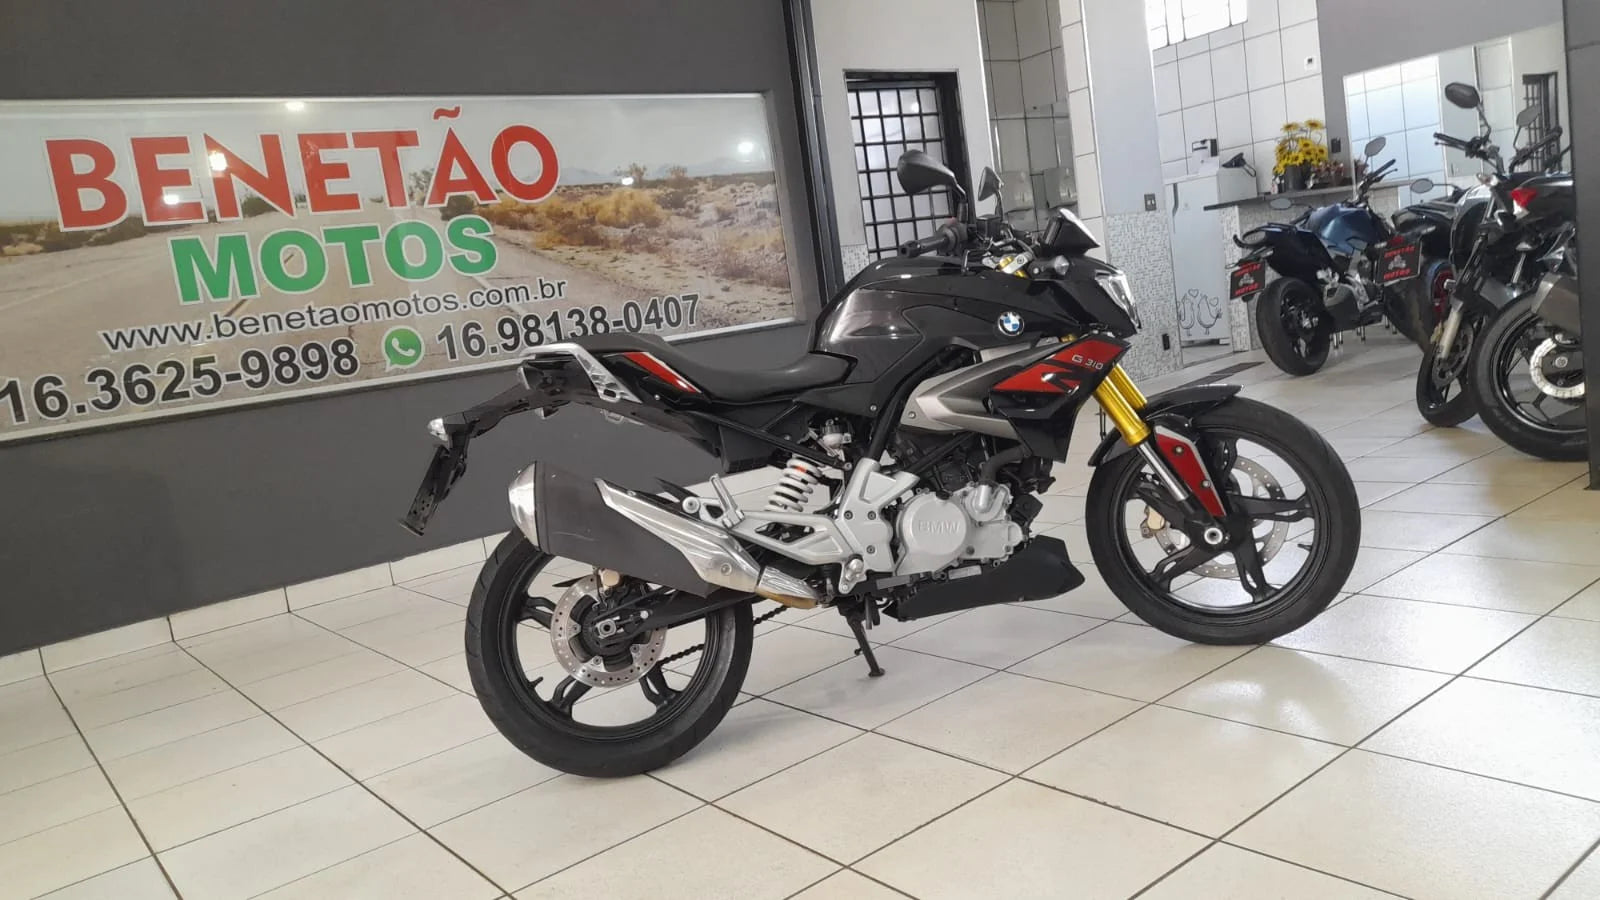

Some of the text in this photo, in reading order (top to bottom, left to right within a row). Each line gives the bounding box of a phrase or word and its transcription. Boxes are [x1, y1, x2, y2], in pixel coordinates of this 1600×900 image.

[45, 106, 560, 230] BENETÃO
[170, 217, 498, 303] MOTOS
[102, 279, 567, 351] www.benetaomotos.com.br
[437, 294, 699, 360] 16.98138-0407
[0, 338, 359, 423] 16.3625-9898
[1072, 354, 1104, 370] G 310
[918, 520, 961, 534] BMW
